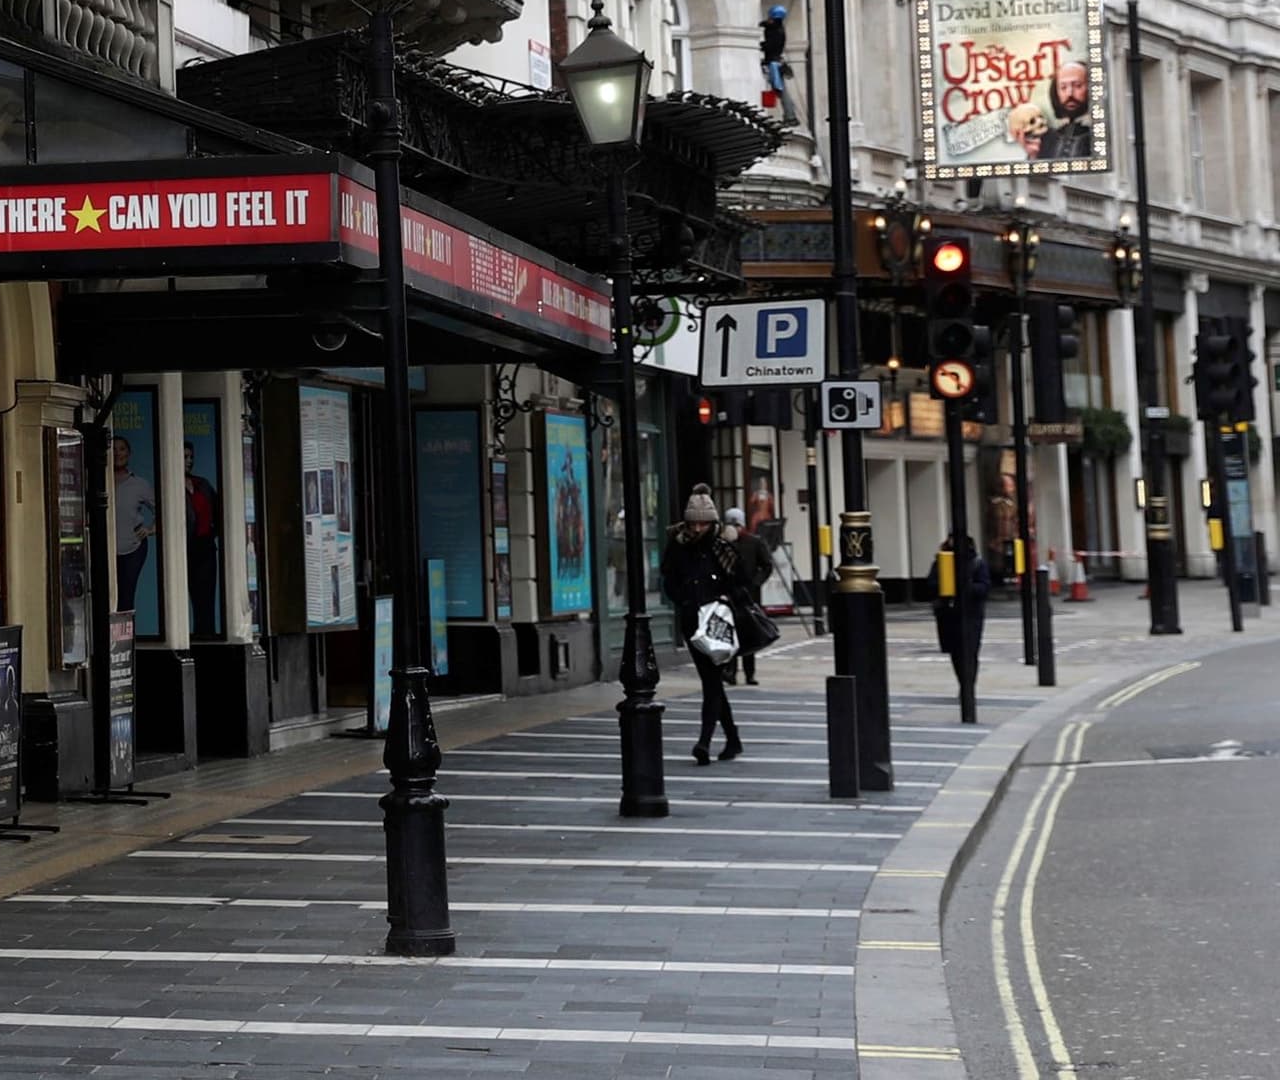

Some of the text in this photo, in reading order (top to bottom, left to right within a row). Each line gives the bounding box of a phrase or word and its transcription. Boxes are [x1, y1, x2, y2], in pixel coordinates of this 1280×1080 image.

[937, 2, 990, 22] David
[108, 193, 162, 231] CAN
[167, 191, 219, 230] YOU
[225, 189, 278, 227] FEEL
[283, 188, 309, 225] IT
[766, 313, 799, 354] P
[745, 365, 814, 377] Chinatown
